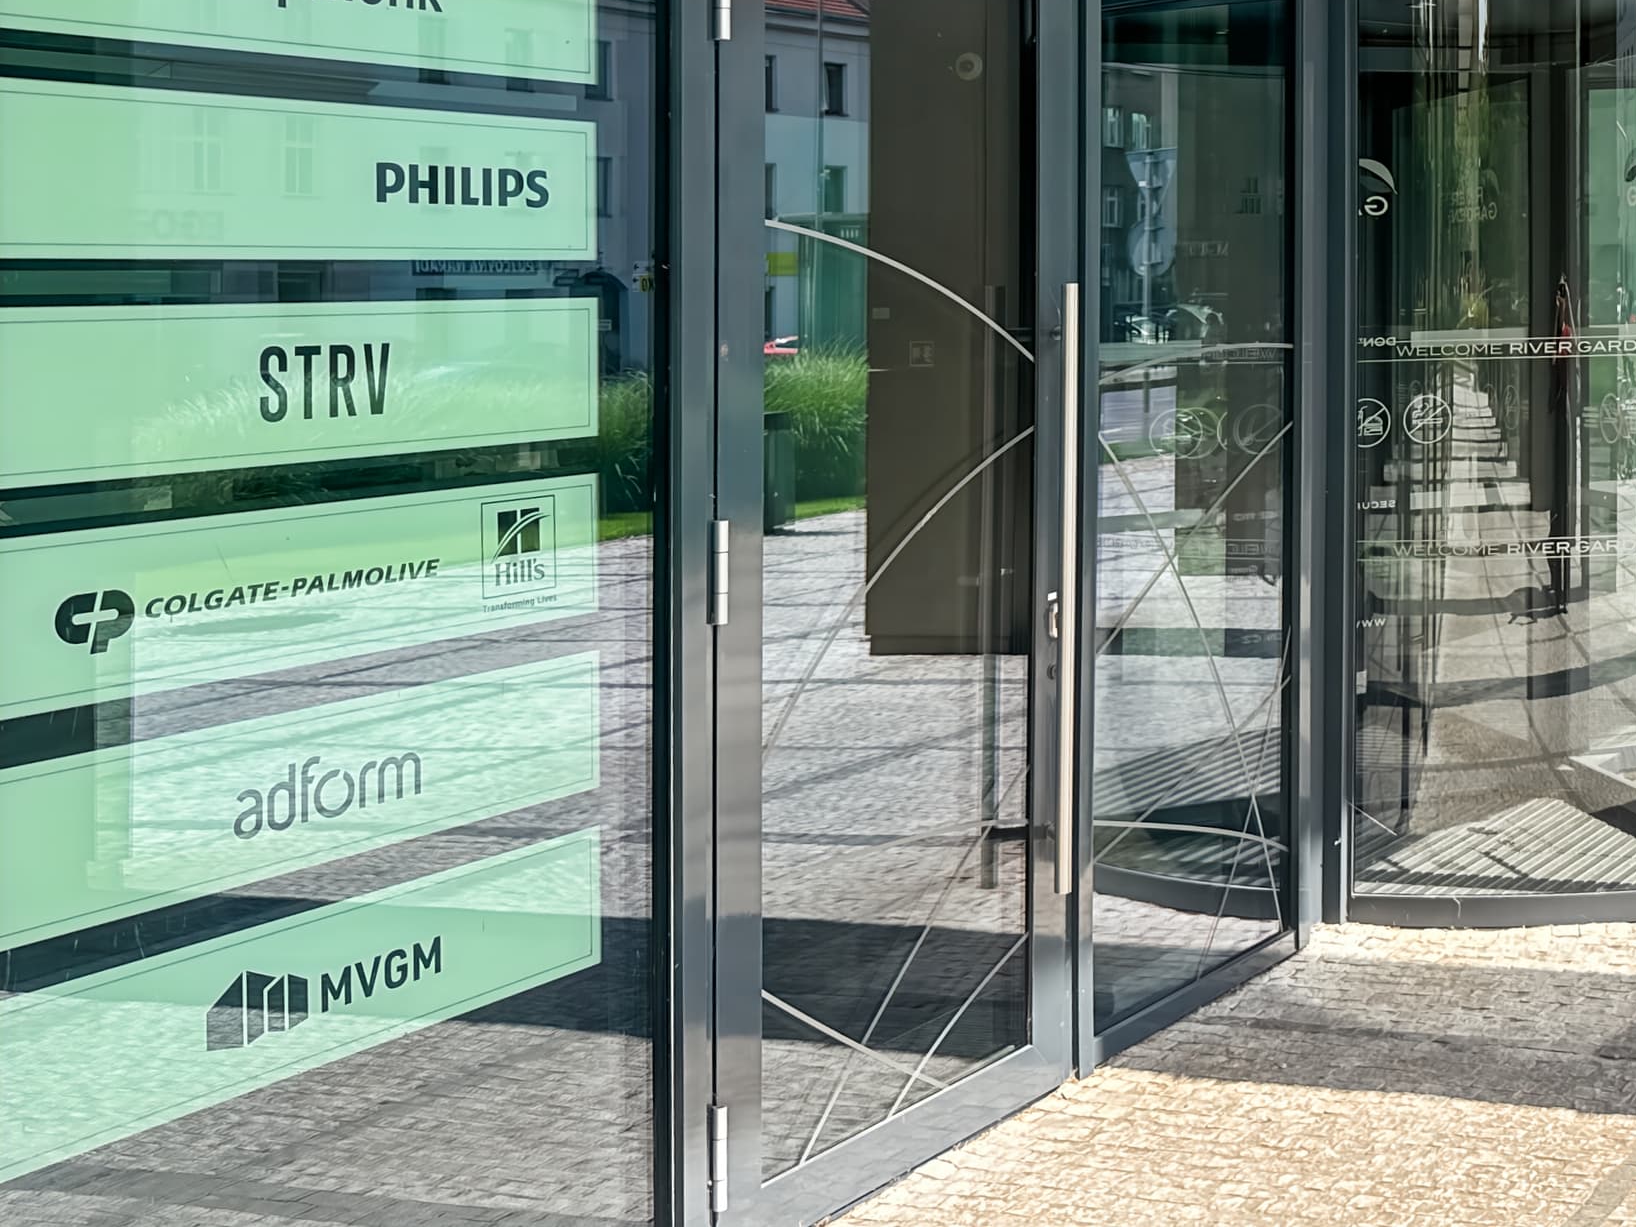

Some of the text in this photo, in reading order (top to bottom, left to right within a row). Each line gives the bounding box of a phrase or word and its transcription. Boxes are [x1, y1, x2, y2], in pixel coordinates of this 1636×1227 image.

[375, 161, 550, 210] PHILIPS
[1396, 343, 1504, 358] WELCOME
[1508, 341, 1573, 356] RIVER
[259, 342, 391, 423] STRV
[494, 557, 546, 587] Hill's
[1392, 543, 1500, 557] WELCOME
[1506, 541, 1571, 555] RIVER
[144, 557, 441, 619] COLGATE-PALMOLIVE
[482, 598, 535, 613] Transforming
[233, 751, 423, 840] adform
[320, 935, 443, 1014] MVGM
